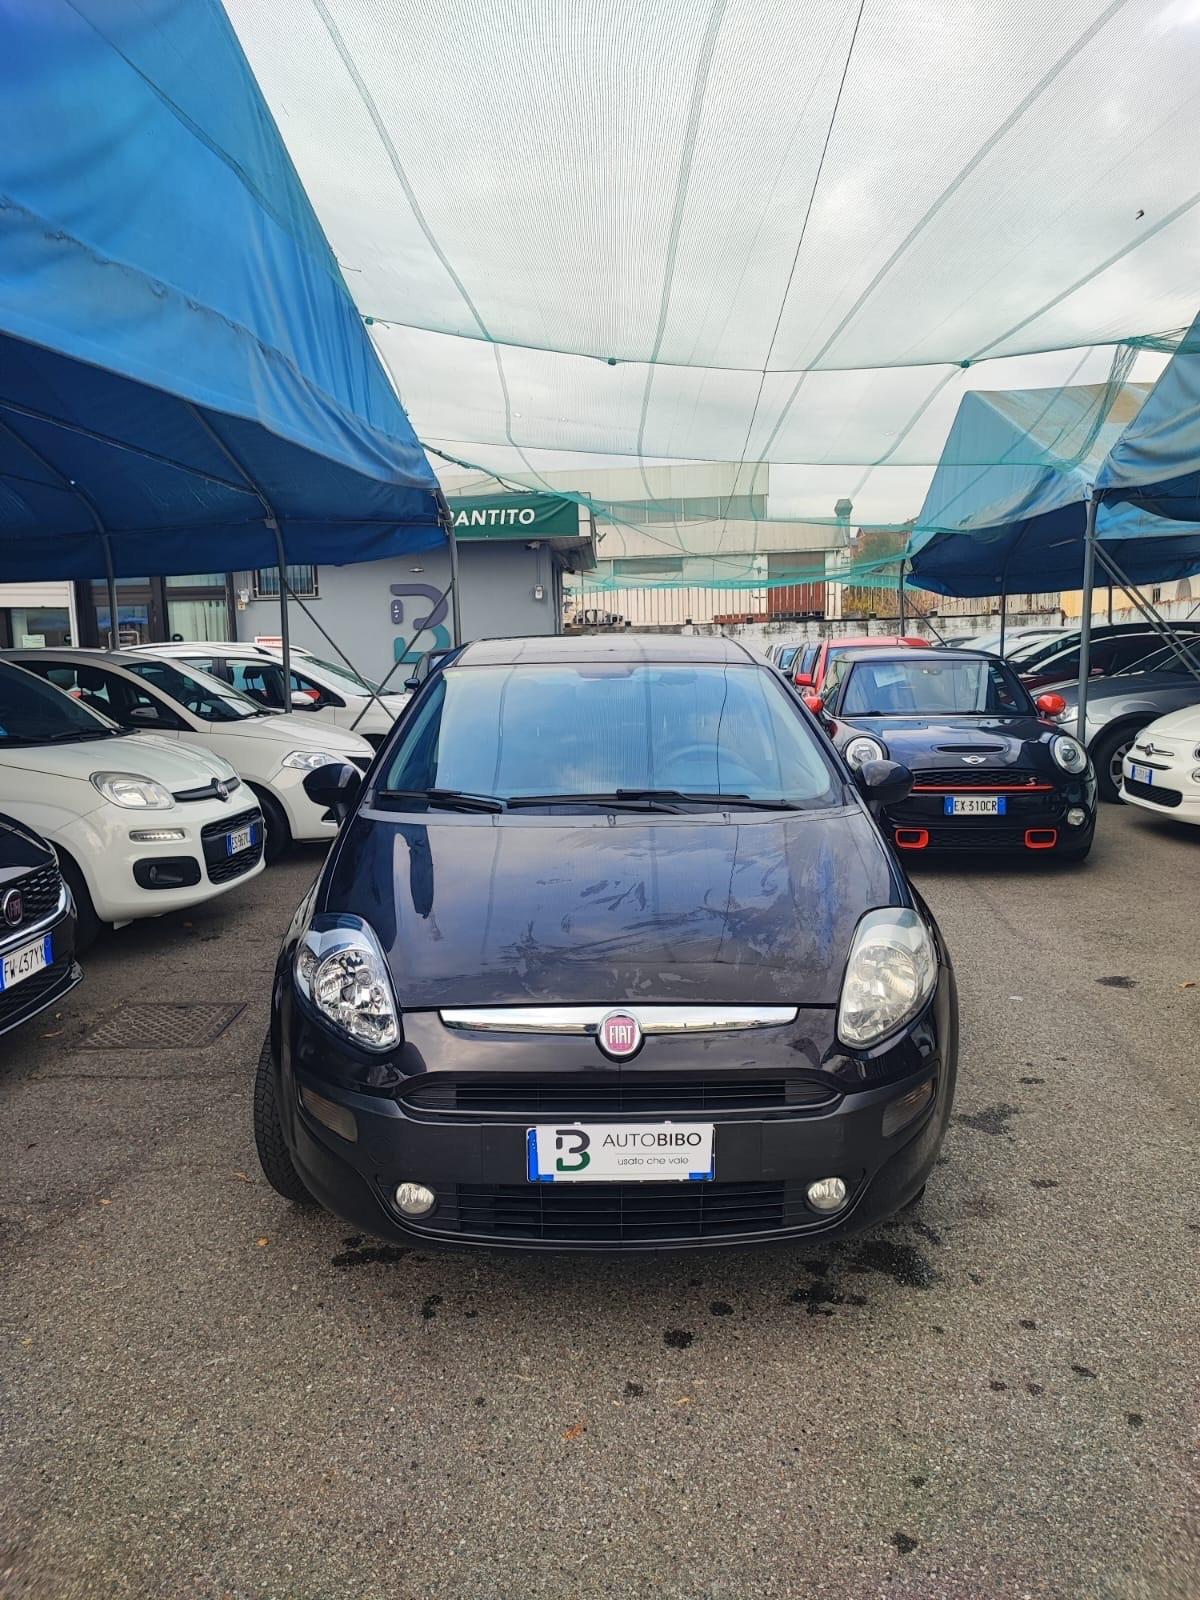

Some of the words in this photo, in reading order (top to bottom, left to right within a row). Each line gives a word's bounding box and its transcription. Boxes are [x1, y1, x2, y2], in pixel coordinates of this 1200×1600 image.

[609, 1025, 632, 1044] FIAT
[602, 1132, 702, 1147] AUTOBIBO
[617, 1156, 644, 1166] usato
[646, 1156, 666, 1165] che
[668, 1156, 689, 1165] vale
